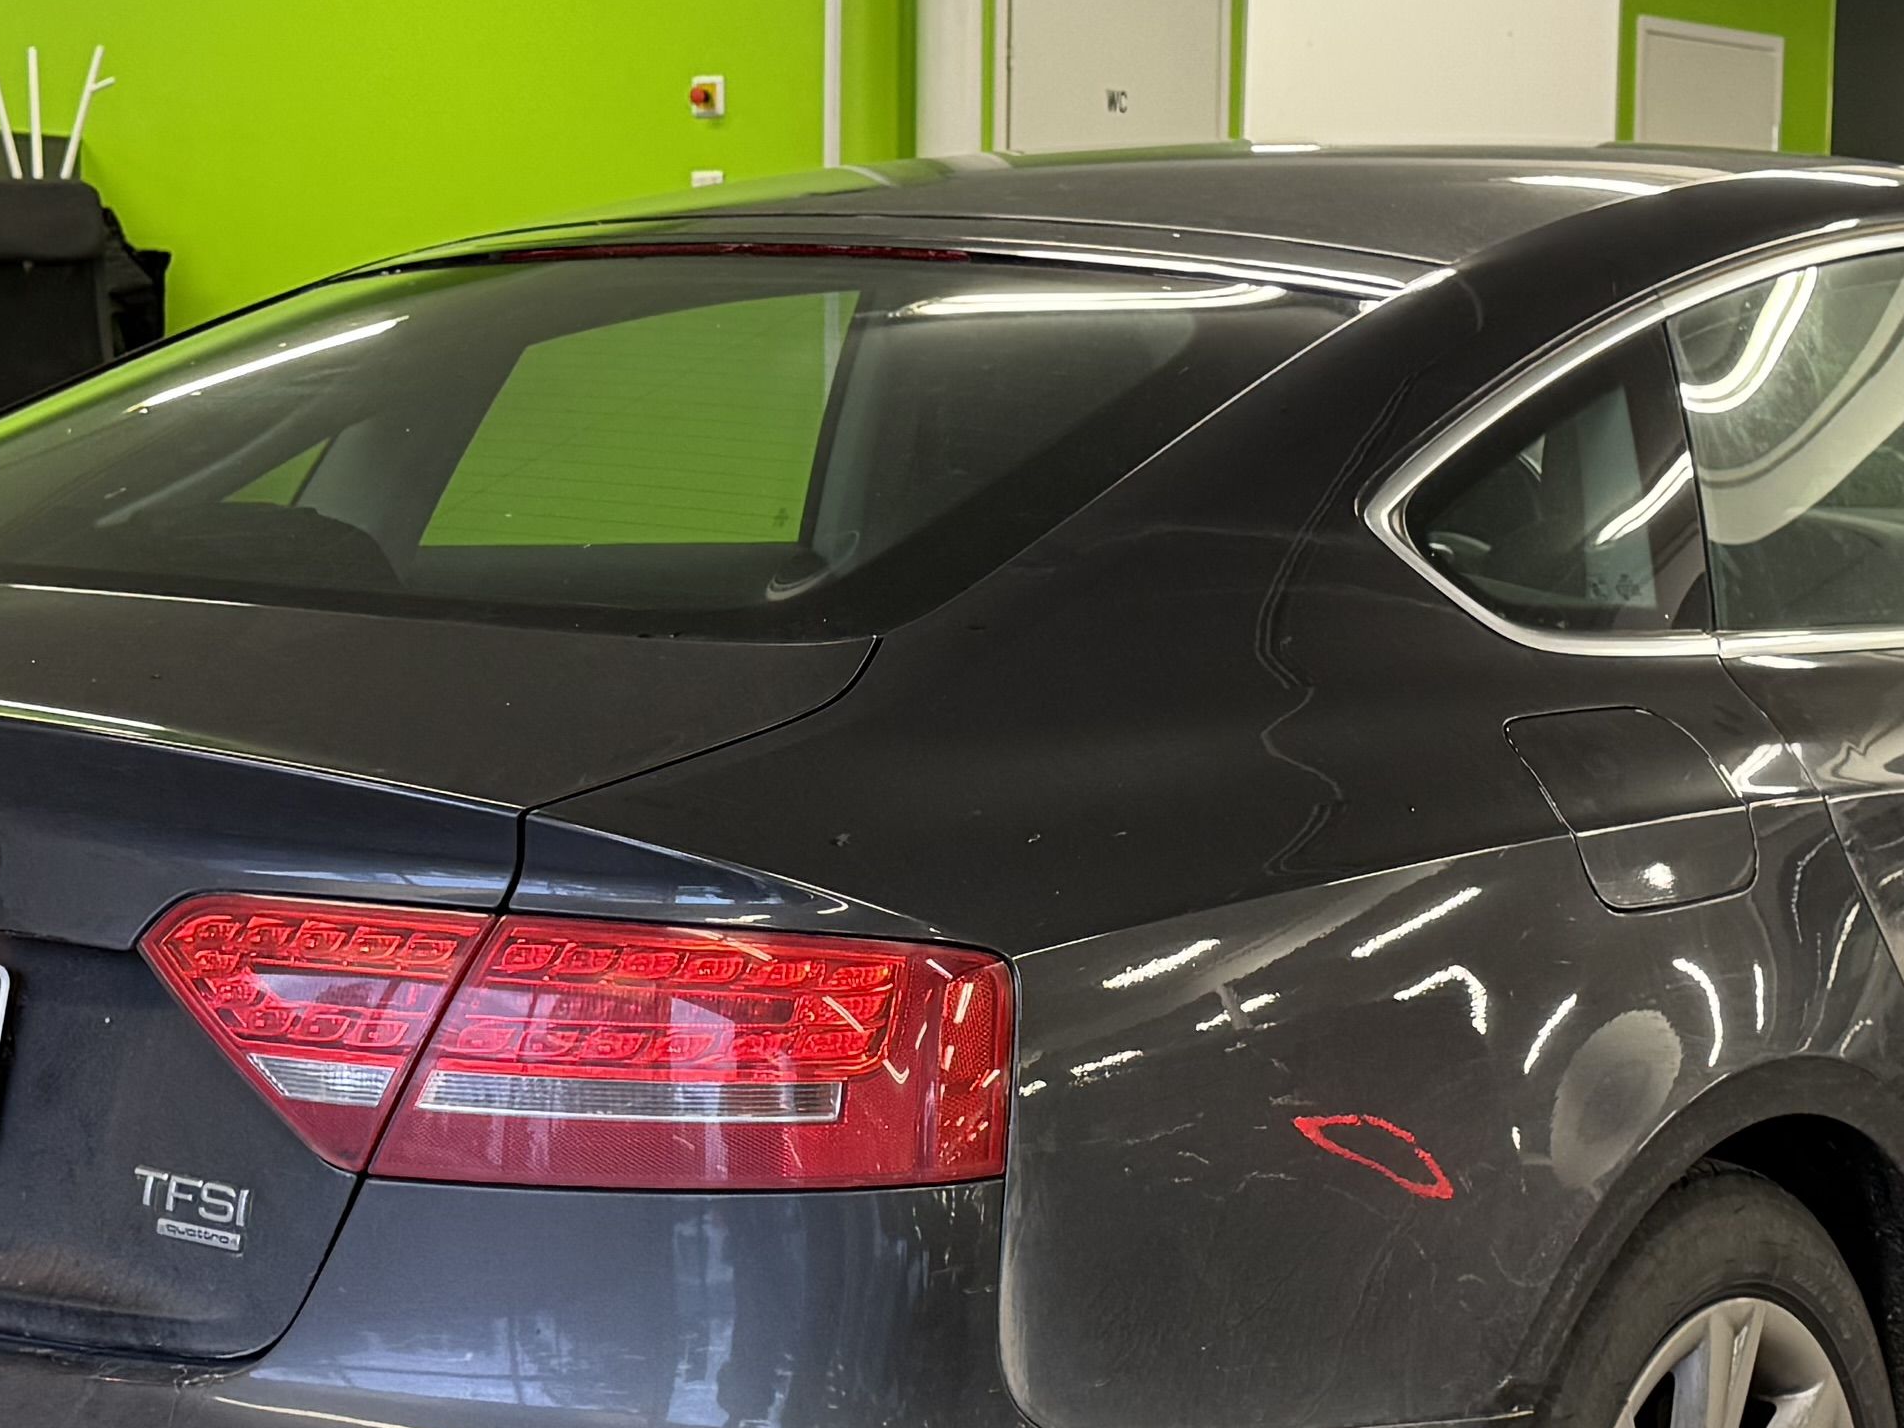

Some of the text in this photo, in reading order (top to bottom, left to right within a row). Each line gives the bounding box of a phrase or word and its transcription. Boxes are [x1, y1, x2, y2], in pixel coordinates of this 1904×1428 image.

[1105, 89, 1128, 114] WC
[134, 1167, 250, 1227] TFSI
[166, 1223, 230, 1245] quattro
